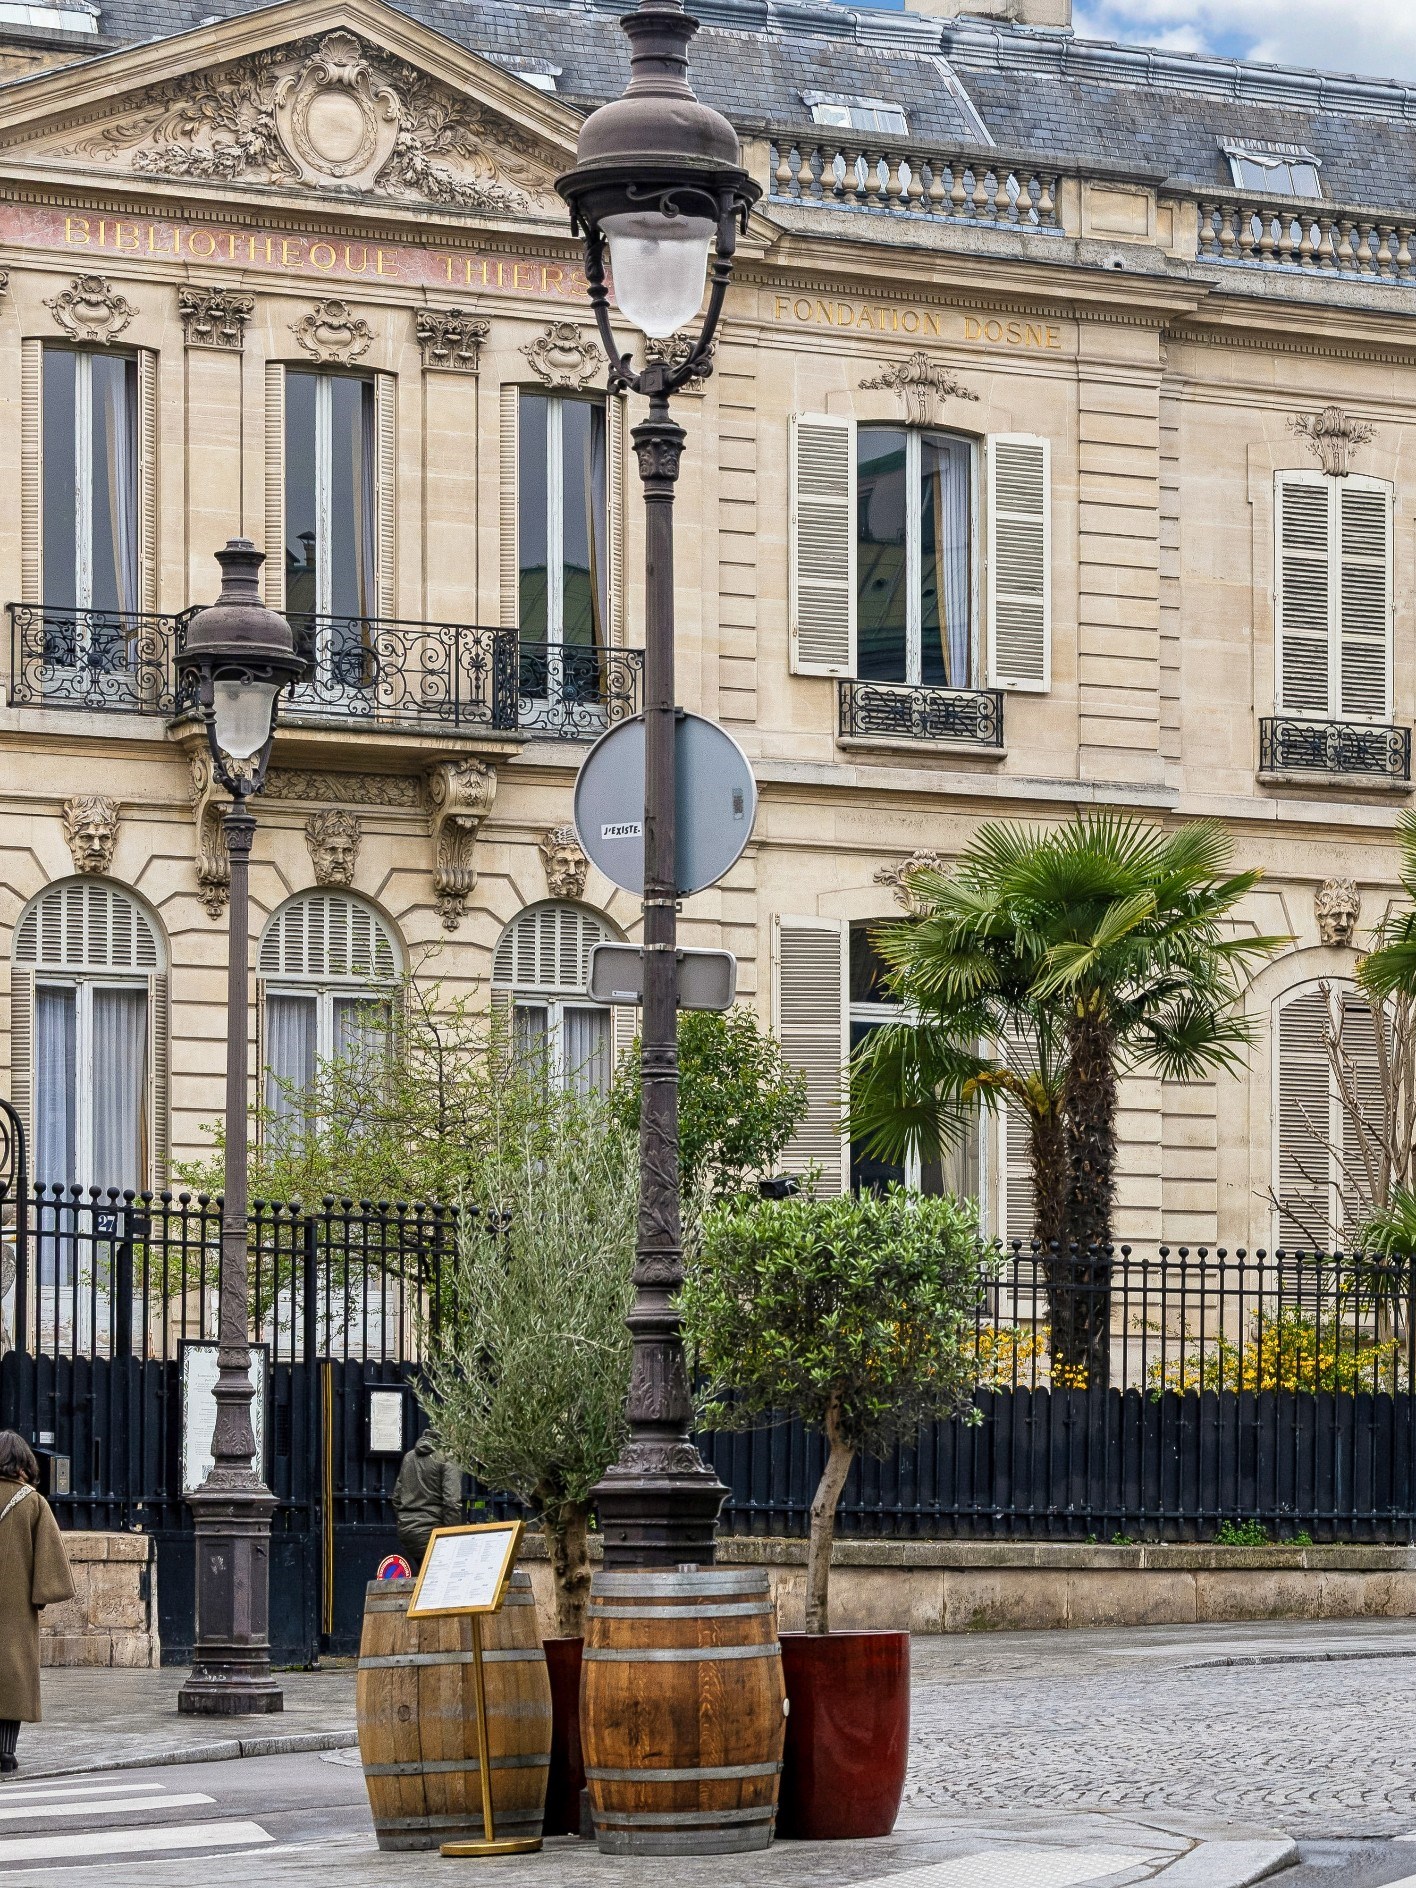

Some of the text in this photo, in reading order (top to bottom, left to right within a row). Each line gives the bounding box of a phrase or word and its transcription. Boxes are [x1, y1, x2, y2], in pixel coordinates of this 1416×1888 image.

[64, 217, 590, 296] BIBLIOTHEQUE THIERS
[774, 296, 1062, 349] FONDATION DOSNE
[603, 825, 641, 835] J'EXISTE.
[98, 1214, 115, 1232] 27
